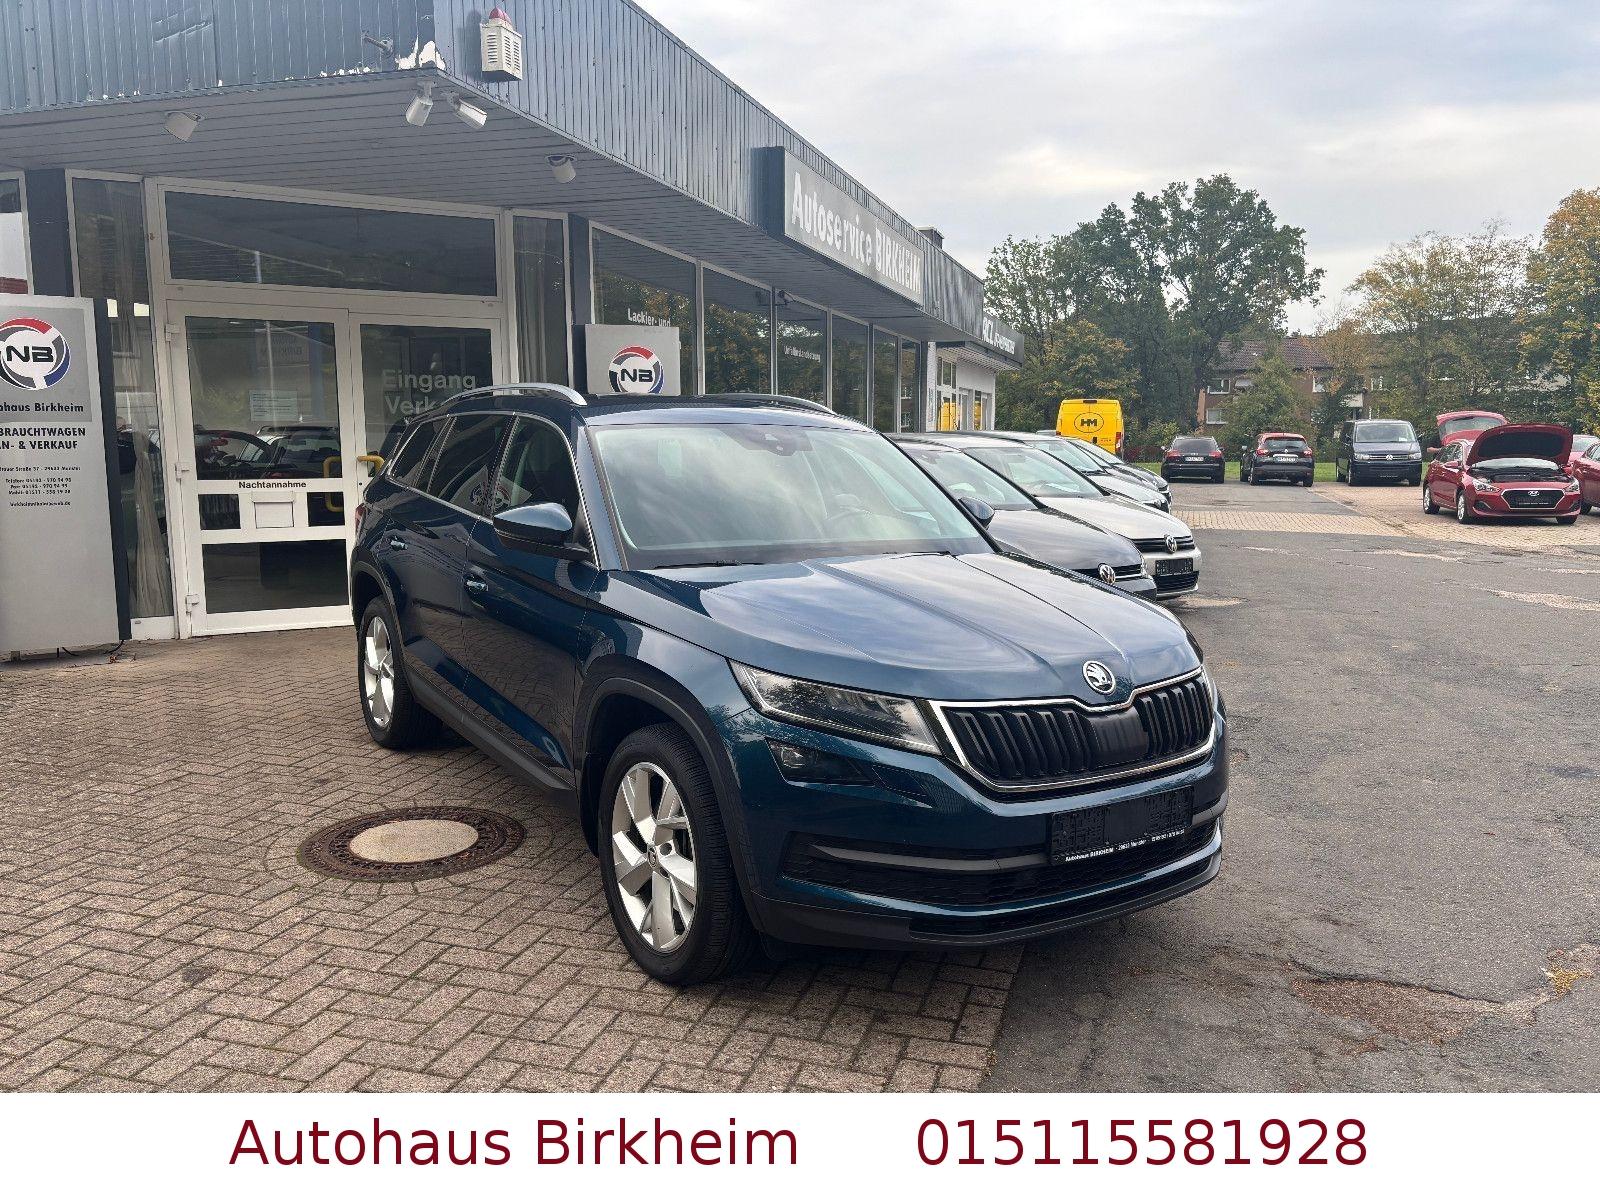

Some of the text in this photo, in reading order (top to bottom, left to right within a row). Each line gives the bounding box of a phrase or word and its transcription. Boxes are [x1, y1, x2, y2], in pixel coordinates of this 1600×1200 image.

[791, 170, 921, 295] Autoservice BIRKHEIM
[6, 345, 54, 363] NB
[383, 369, 476, 393] Eingang
[620, 368, 654, 383] NB
[34, 402, 84, 412] Birkheim
[18, 440, 26, 450] &
[29, 440, 78, 450] VERKAUF
[238, 481, 307, 489] Nachtannahme
